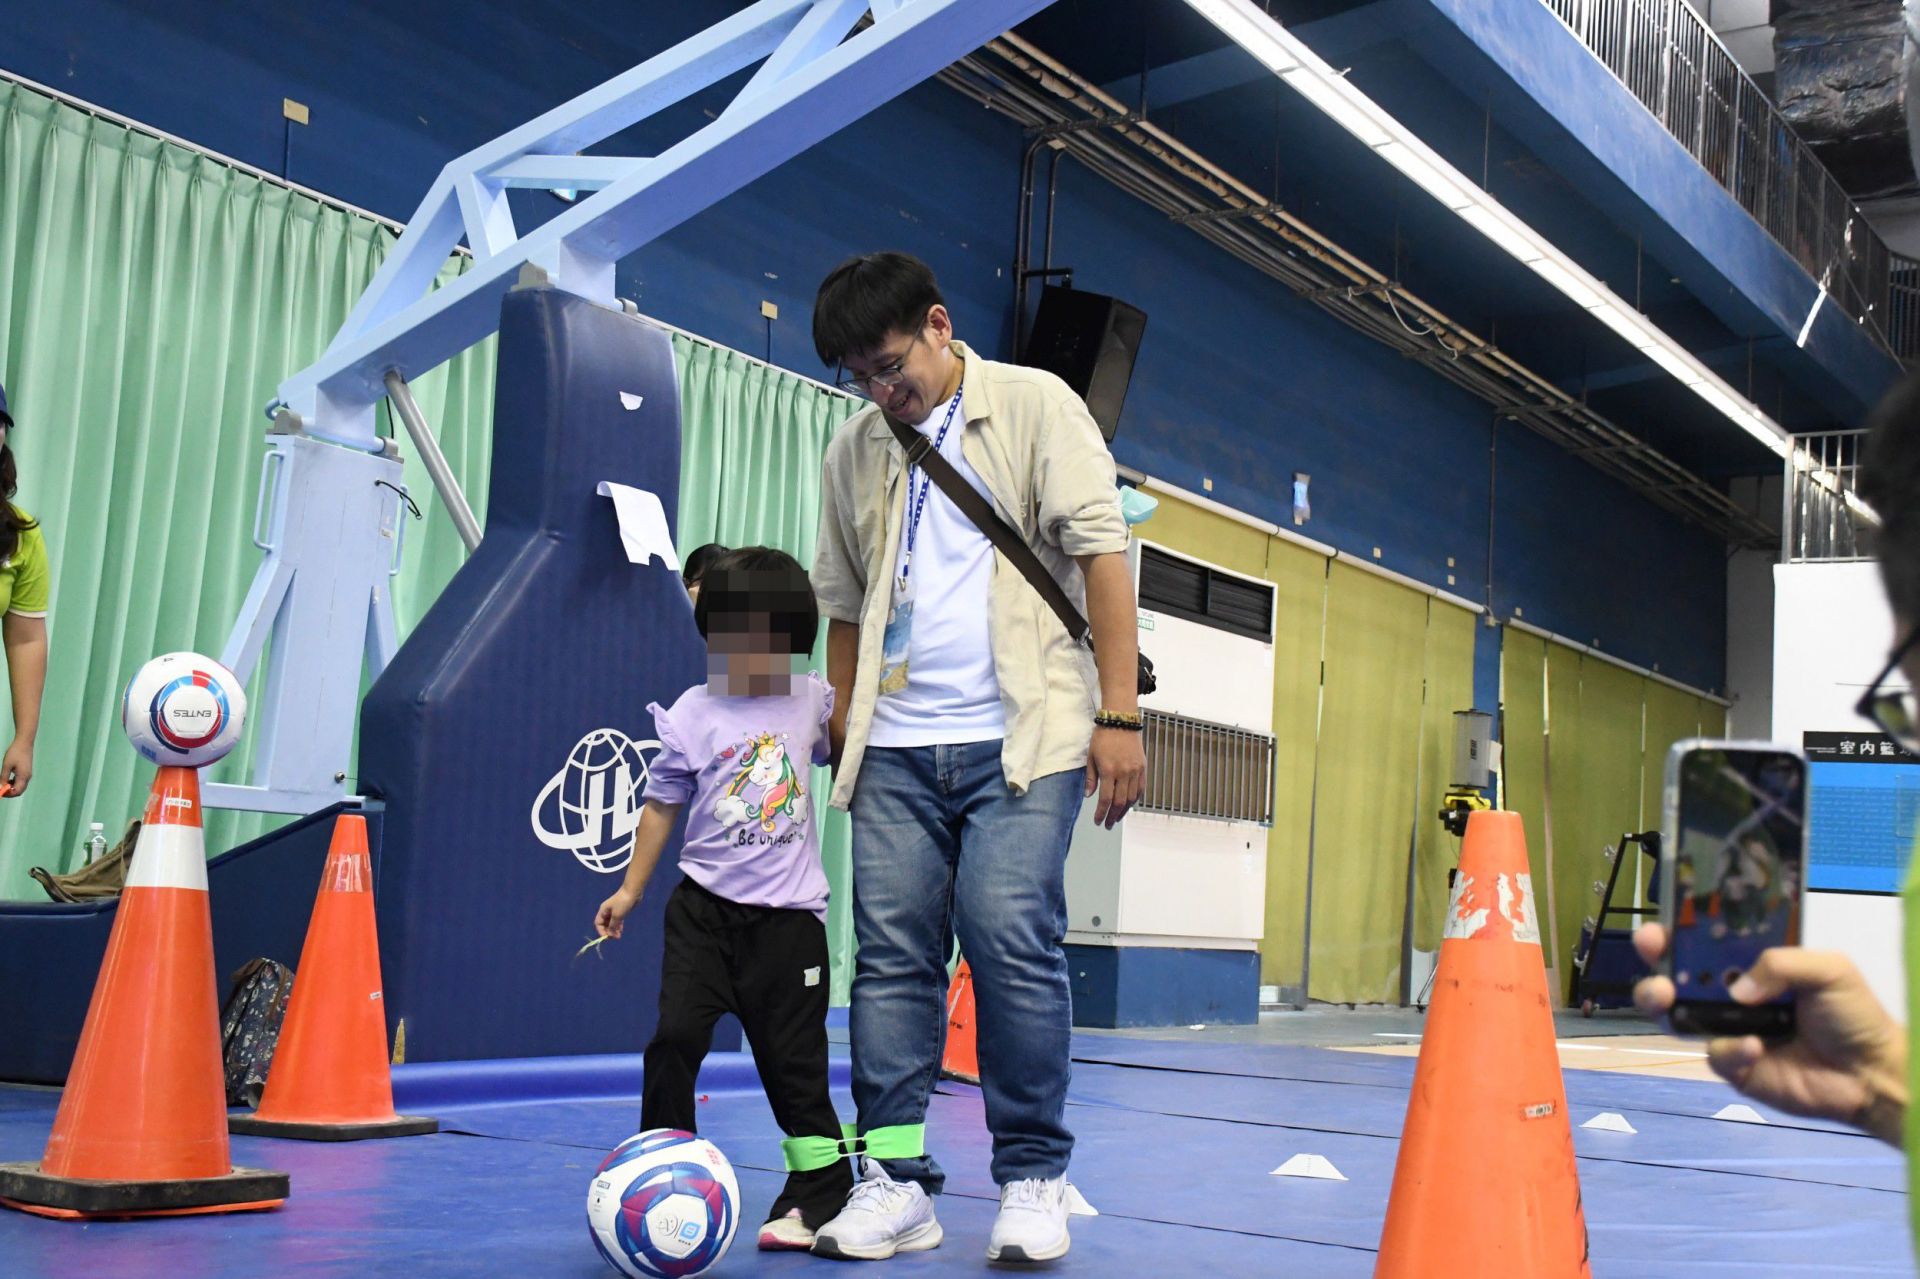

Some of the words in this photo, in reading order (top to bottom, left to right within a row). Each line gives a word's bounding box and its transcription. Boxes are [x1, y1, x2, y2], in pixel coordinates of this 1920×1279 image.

[173, 709, 212, 718] ENTES
[738, 828, 755, 846] Be
[759, 831, 794, 848] unique
